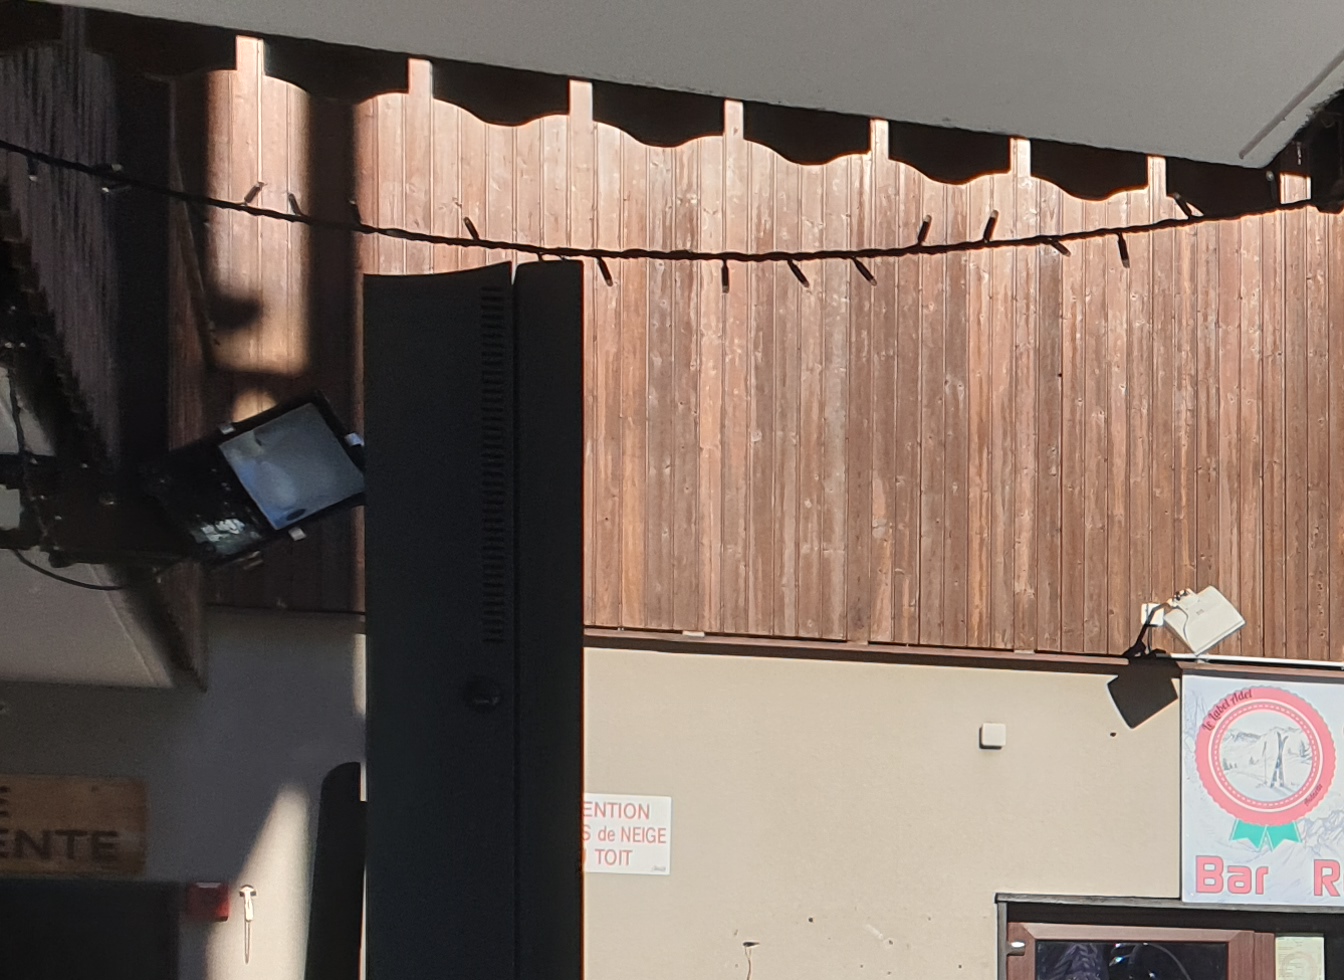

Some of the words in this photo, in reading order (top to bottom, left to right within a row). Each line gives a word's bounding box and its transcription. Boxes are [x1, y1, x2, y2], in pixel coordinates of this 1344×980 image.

[597, 825, 616, 842] de
[621, 826, 667, 844] NEIGE
[595, 848, 633, 866] TOIT
[1195, 855, 1269, 895] Bar
